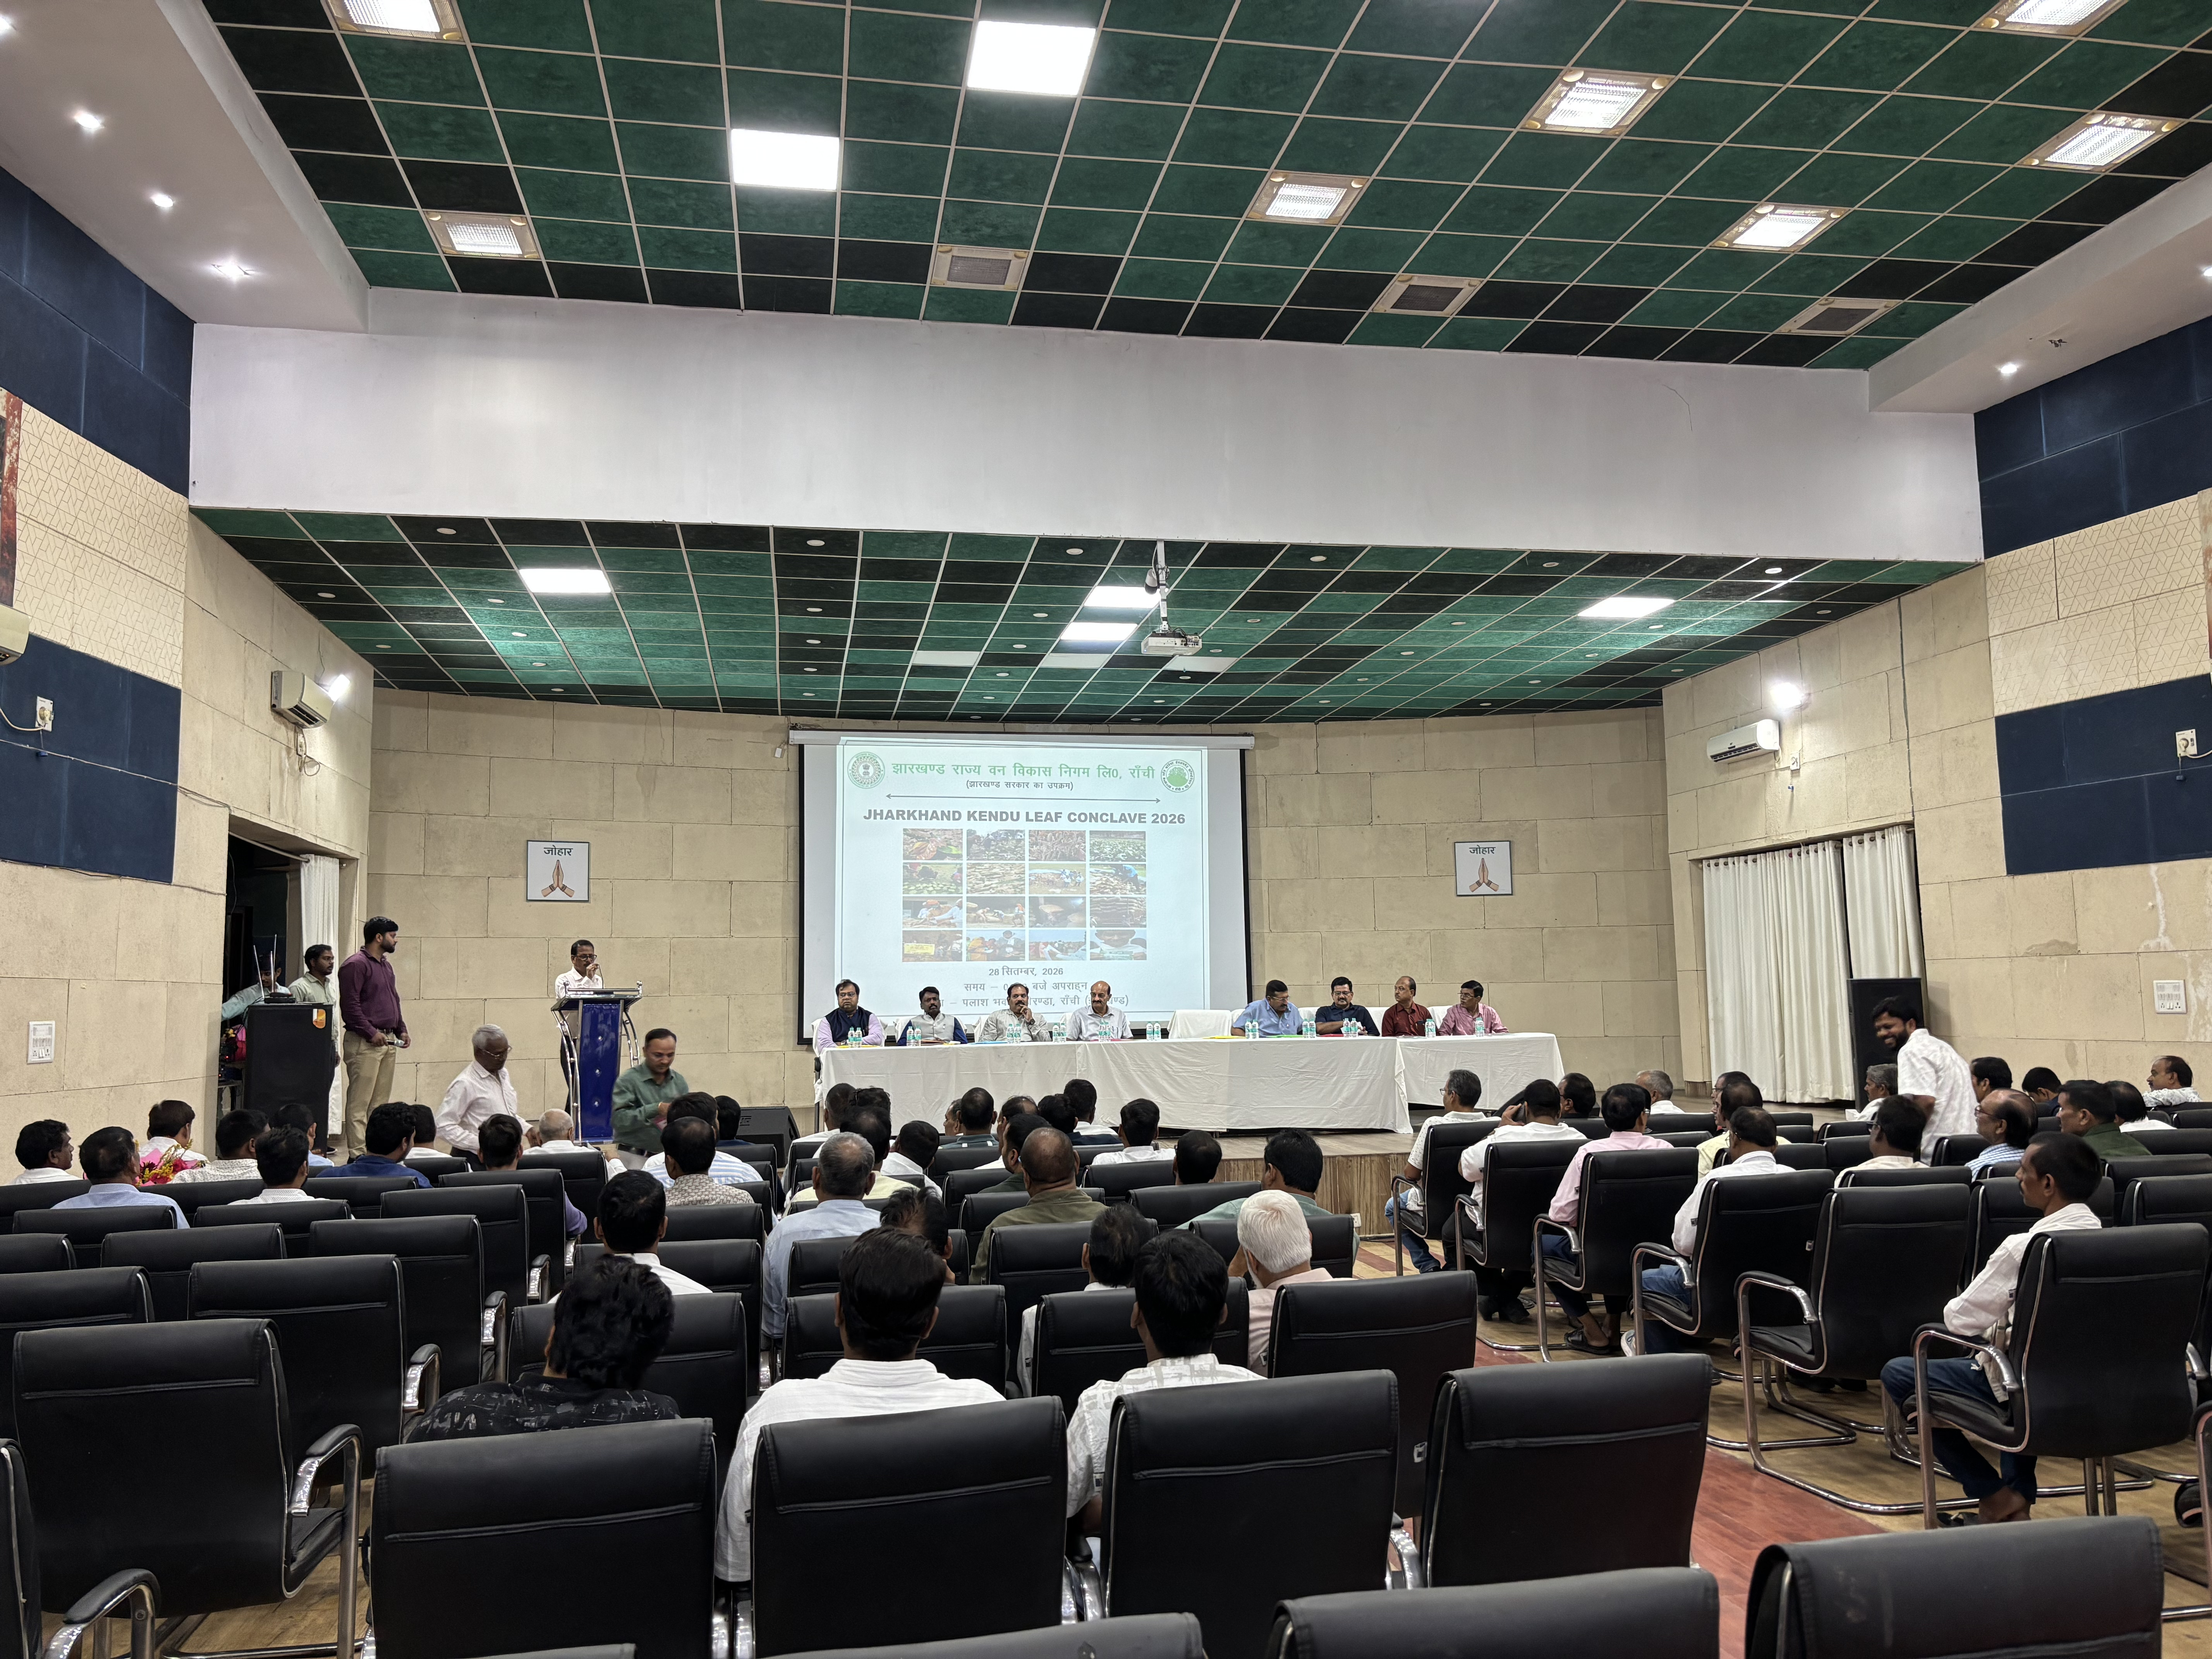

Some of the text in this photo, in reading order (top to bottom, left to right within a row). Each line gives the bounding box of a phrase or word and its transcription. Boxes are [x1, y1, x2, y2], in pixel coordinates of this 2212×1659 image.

[891, 764, 945, 774] झारखण्ड
[951, 765, 981, 775] राज्य
[988, 766, 1006, 776] वन
[1012, 763, 1052, 776] विकास
[1058, 764, 1090, 777] निगम
[1128, 765, 1155, 778] राँची
[966, 780, 1000, 789] (झारखण्ड
[1047, 781, 1073, 791] उपक्रम)
[864, 809, 1185, 824] JHARKHAND KENDU LEAF CONCLAVE 2026
[543, 845, 573, 856] जोहार
[1469, 845, 1496, 854] जोहार
[1001, 965, 1036, 976] सितम्बर,
[1032, 980, 1047, 990] बजे
[1060, 994, 1080, 1005] राँची
